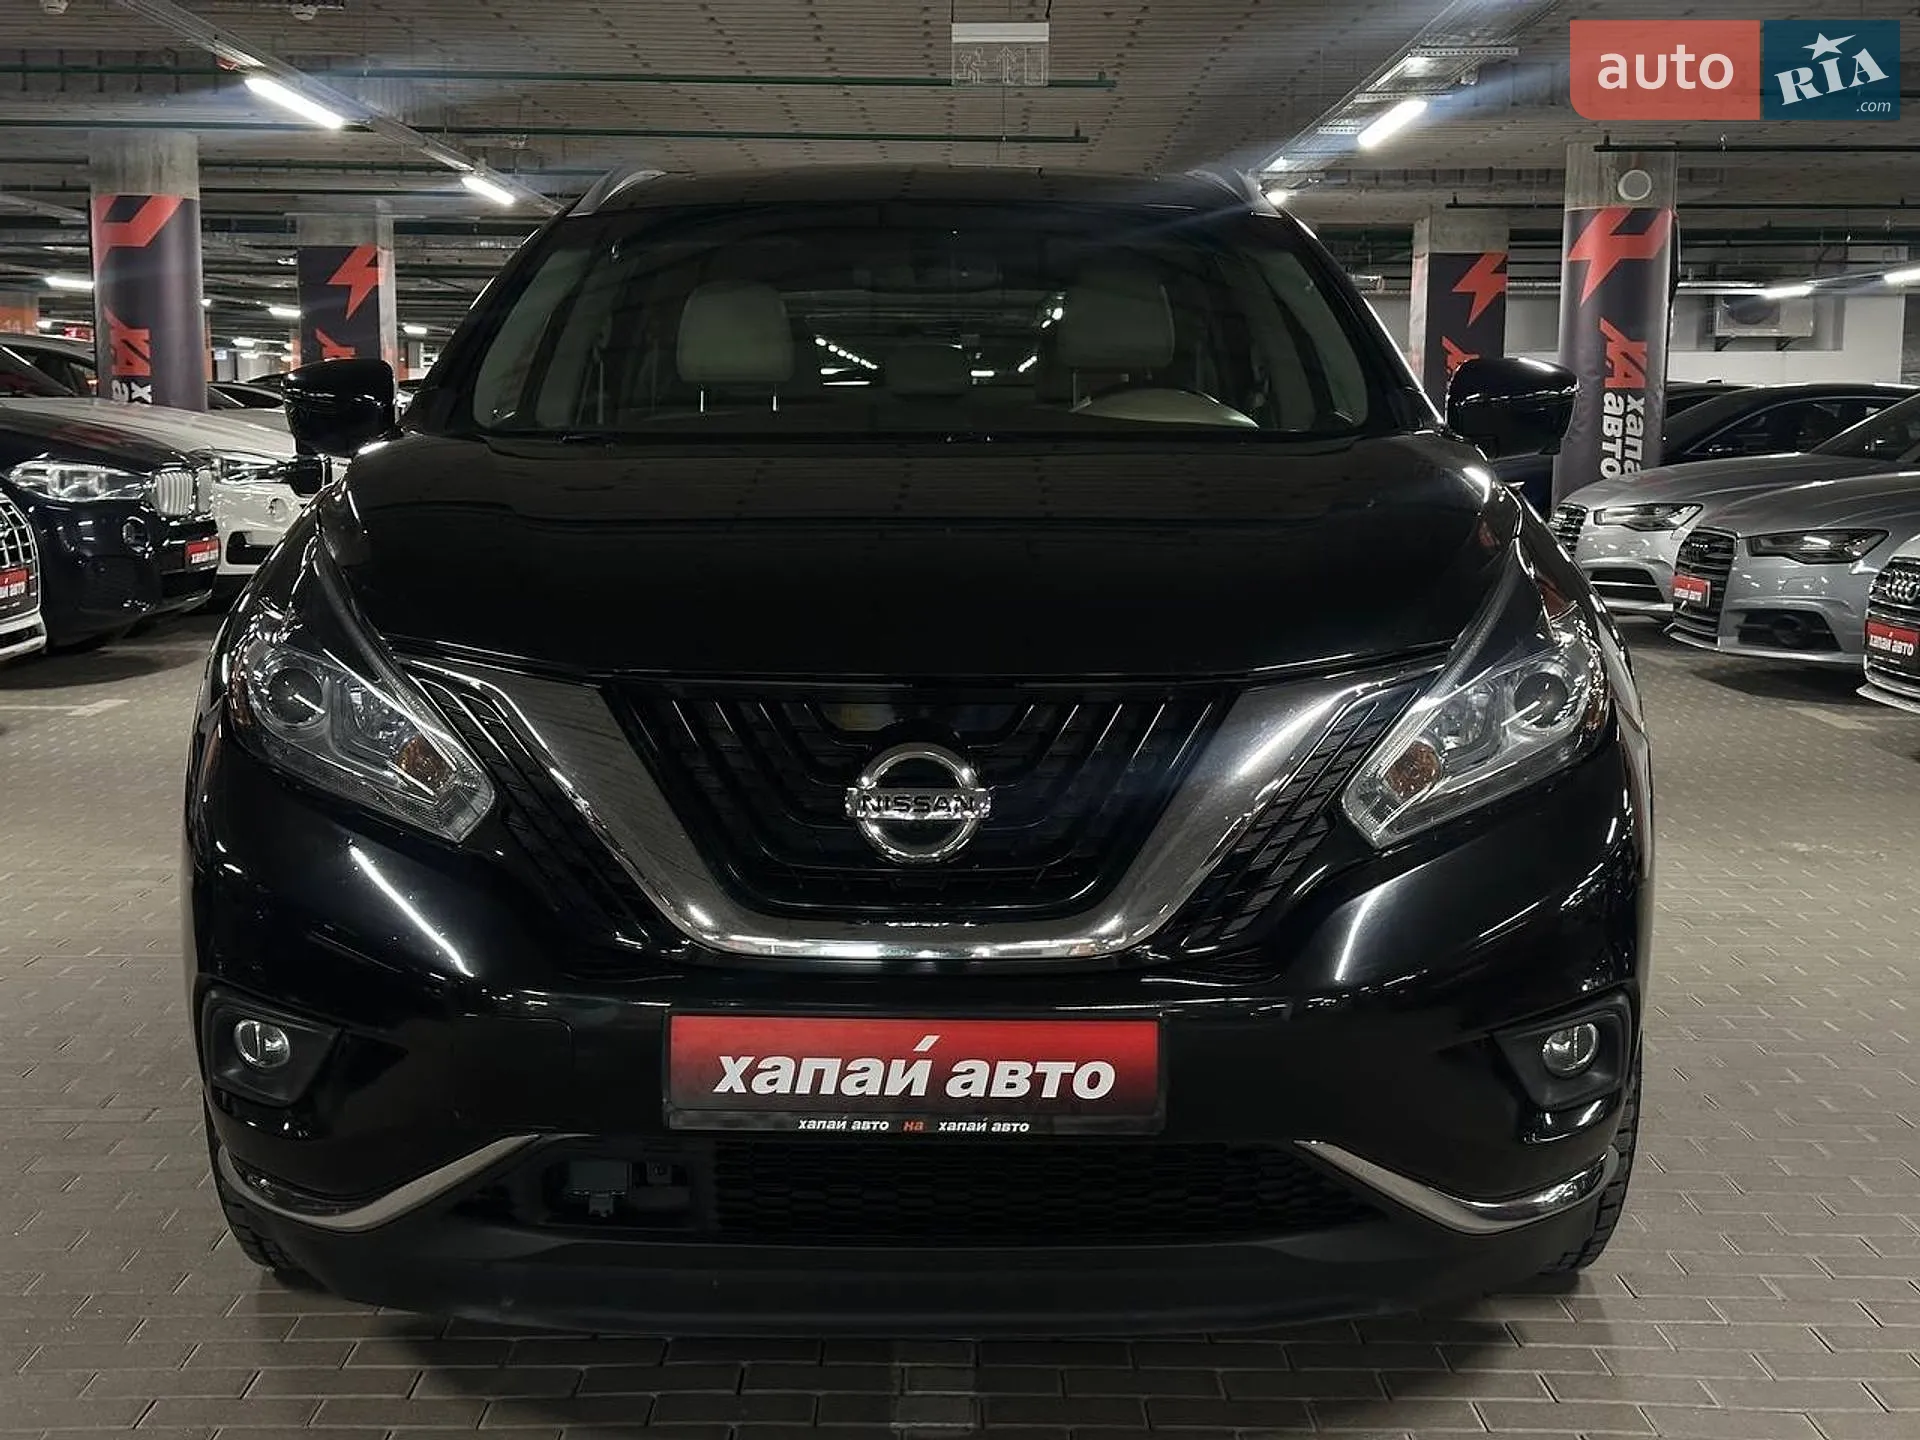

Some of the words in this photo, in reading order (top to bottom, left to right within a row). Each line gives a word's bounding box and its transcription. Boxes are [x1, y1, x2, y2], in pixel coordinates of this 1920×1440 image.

[1600, 392, 1625, 479] авто
[861, 794, 976, 813] NISSAN
[944, 1060, 1117, 1100] авто
[851, 1118, 890, 1131] авто
[903, 1120, 925, 1132] на
[991, 1119, 1030, 1133] авто
